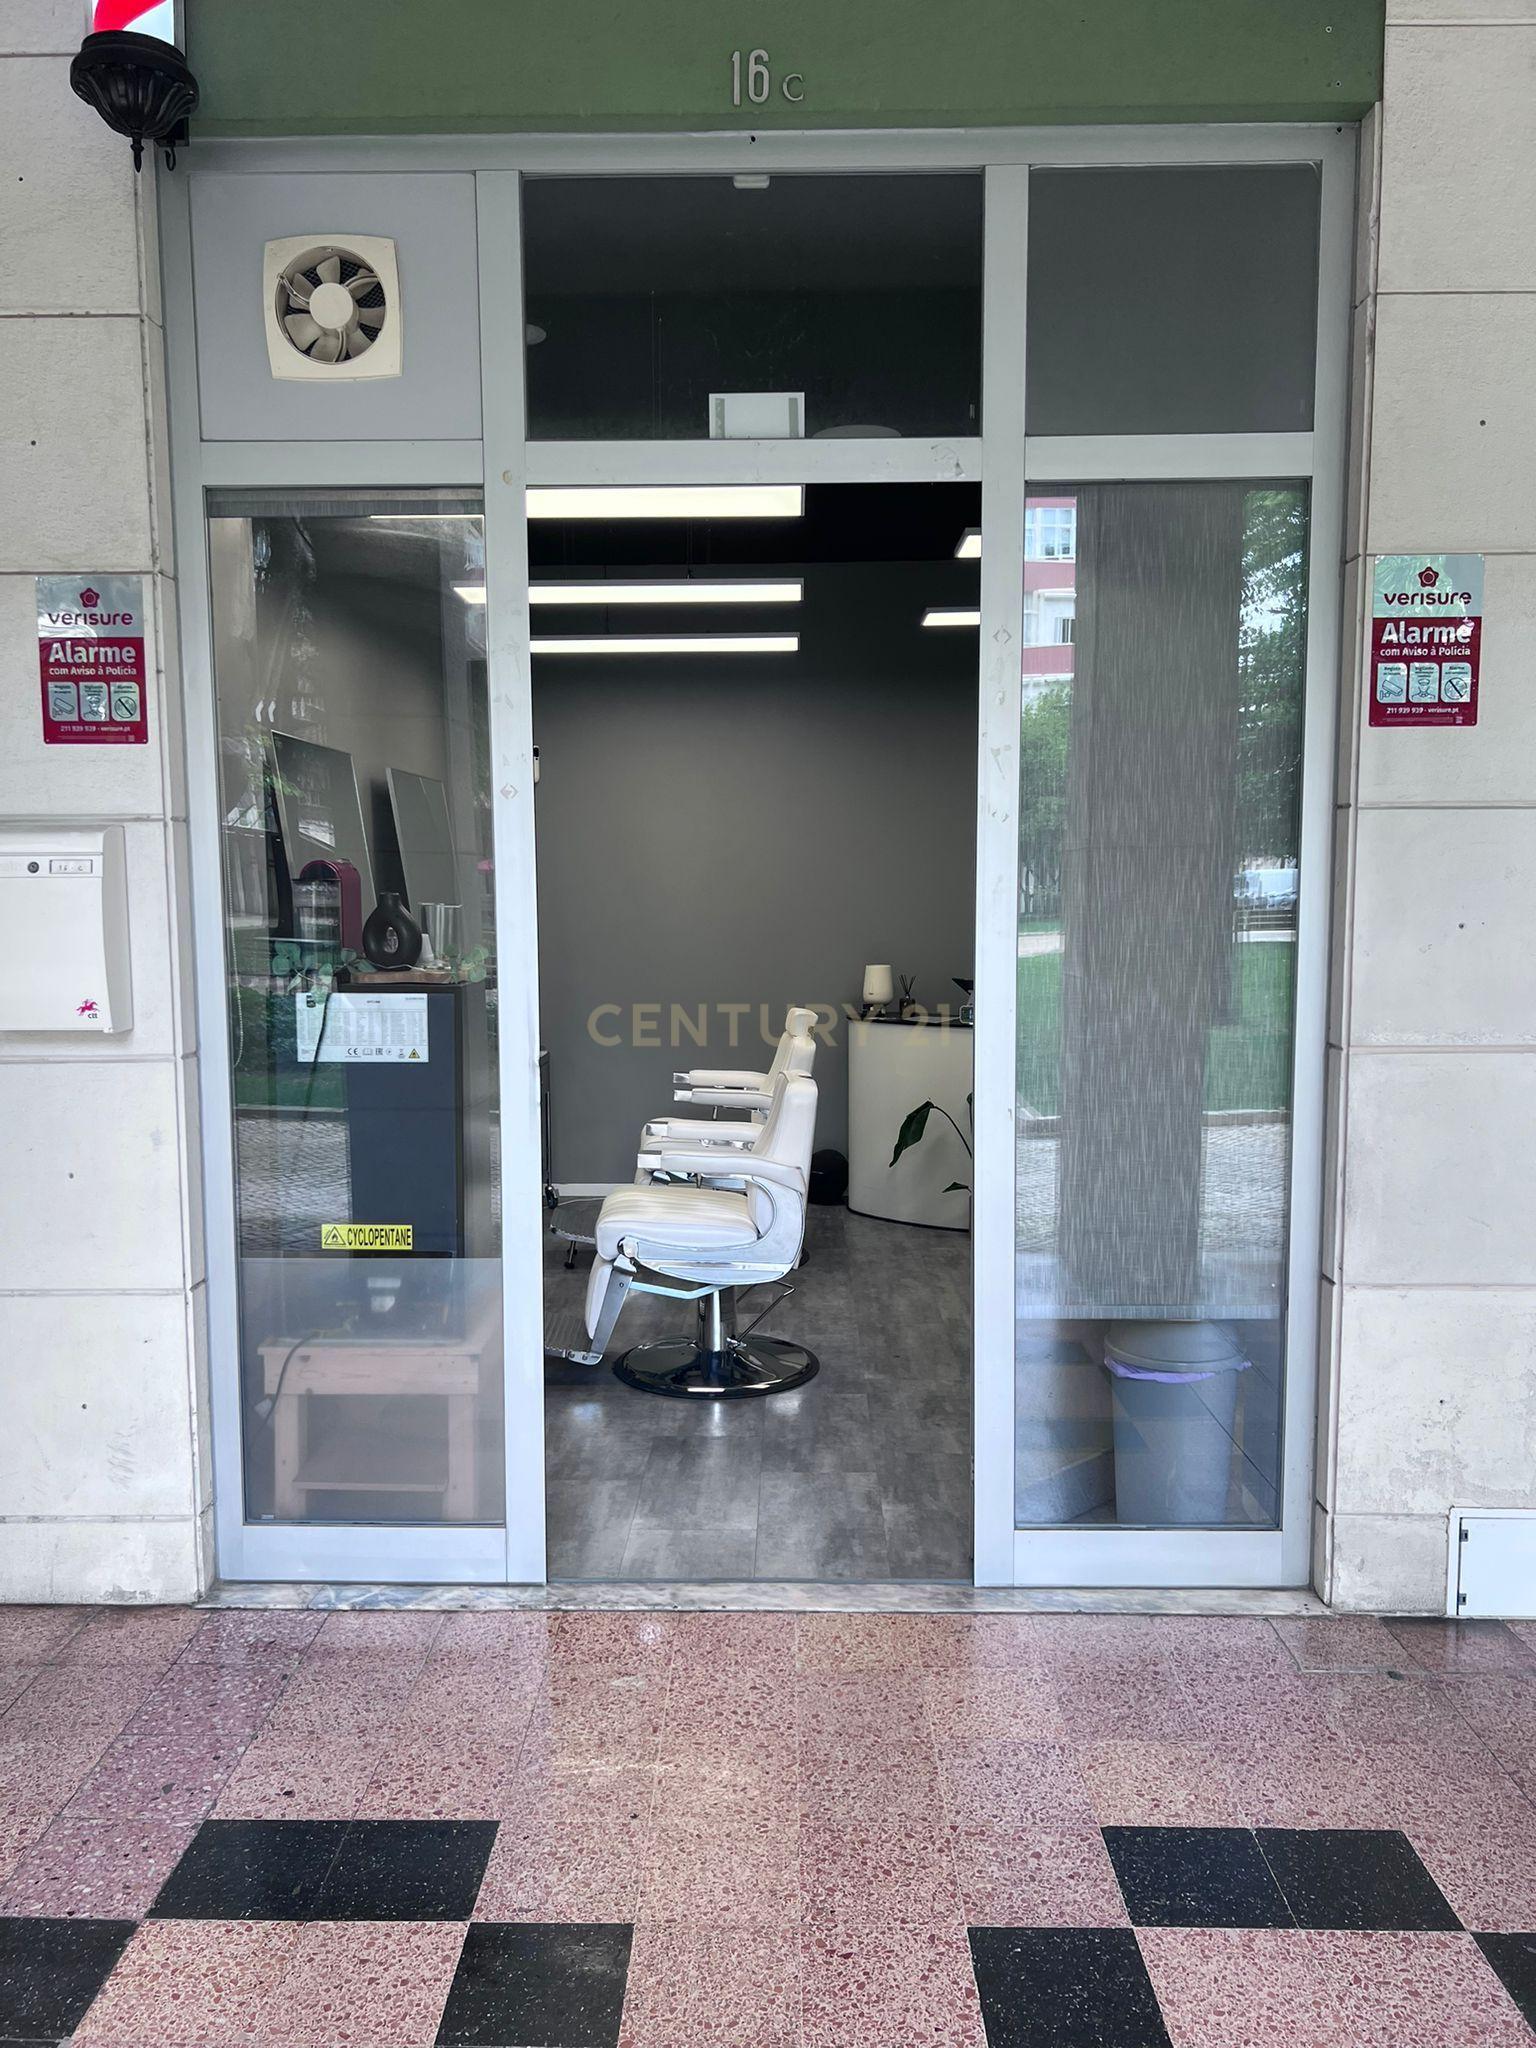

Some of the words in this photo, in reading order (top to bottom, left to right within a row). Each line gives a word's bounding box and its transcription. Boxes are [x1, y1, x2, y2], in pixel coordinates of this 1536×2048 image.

[731, 49, 770, 106] 16
[1383, 592, 1472, 605] verisure
[47, 612, 134, 626] verisure
[1381, 621, 1471, 644] Alarme
[48, 640, 136, 663] Alarme
[1380, 648, 1400, 657] com
[1402, 646, 1428, 656] Aviso
[1438, 645, 1471, 656] Polícia
[49, 667, 69, 676] com
[70, 665, 96, 676] Aviso
[105, 665, 137, 676] Polícia
[347, 1228, 411, 1246] CYCLOPENTANE
